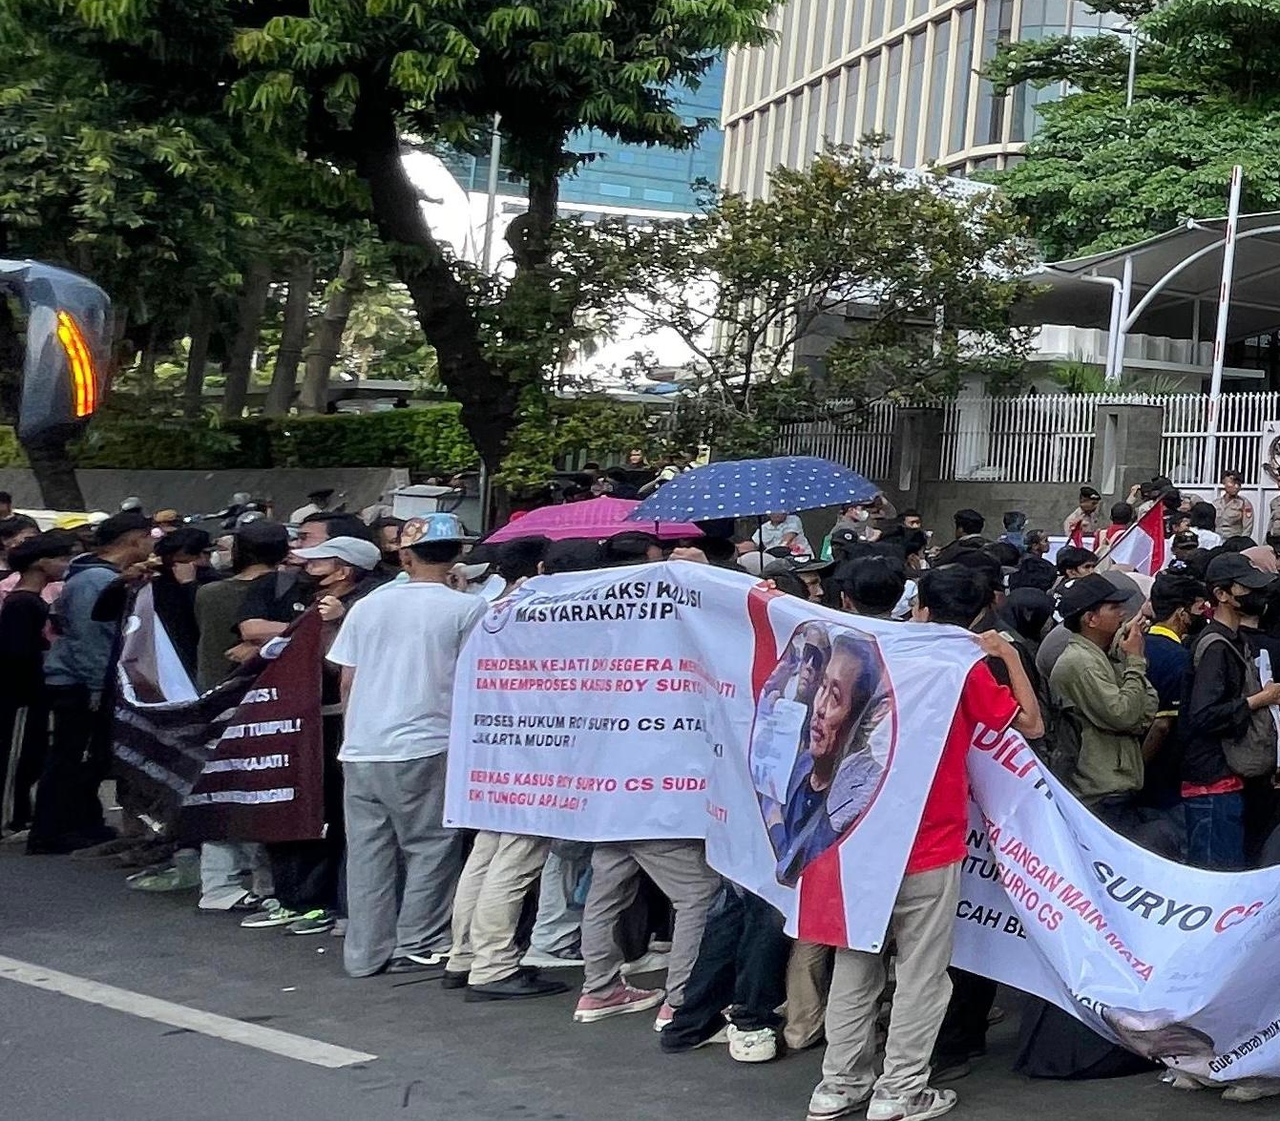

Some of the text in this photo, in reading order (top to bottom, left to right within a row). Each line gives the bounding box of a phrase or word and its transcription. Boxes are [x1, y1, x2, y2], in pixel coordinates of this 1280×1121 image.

[515, 603, 636, 623] MASYARAKAT
[541, 659, 589, 671] KEJATI
[609, 658, 673, 671] SEGERA
[499, 678, 577, 691] MEMPROSES
[615, 679, 649, 692] ROY
[518, 716, 565, 729] HUKUM
[588, 717, 629, 731] SURYO
[638, 718, 666, 732] CS
[973, 721, 1037, 778] DILI
[513, 772, 554, 787] KASUS
[575, 777, 617, 791] SURYO
[625, 778, 654, 791] CS
[488, 791, 536, 806] TUNGGU
[1000, 836, 1064, 894] JANGAN
[1056, 882, 1108, 933] MAIN
[1092, 860, 1213, 933] SURYO
[1036, 901, 1065, 931] CS
[1208, 1052, 1234, 1074] Gue
